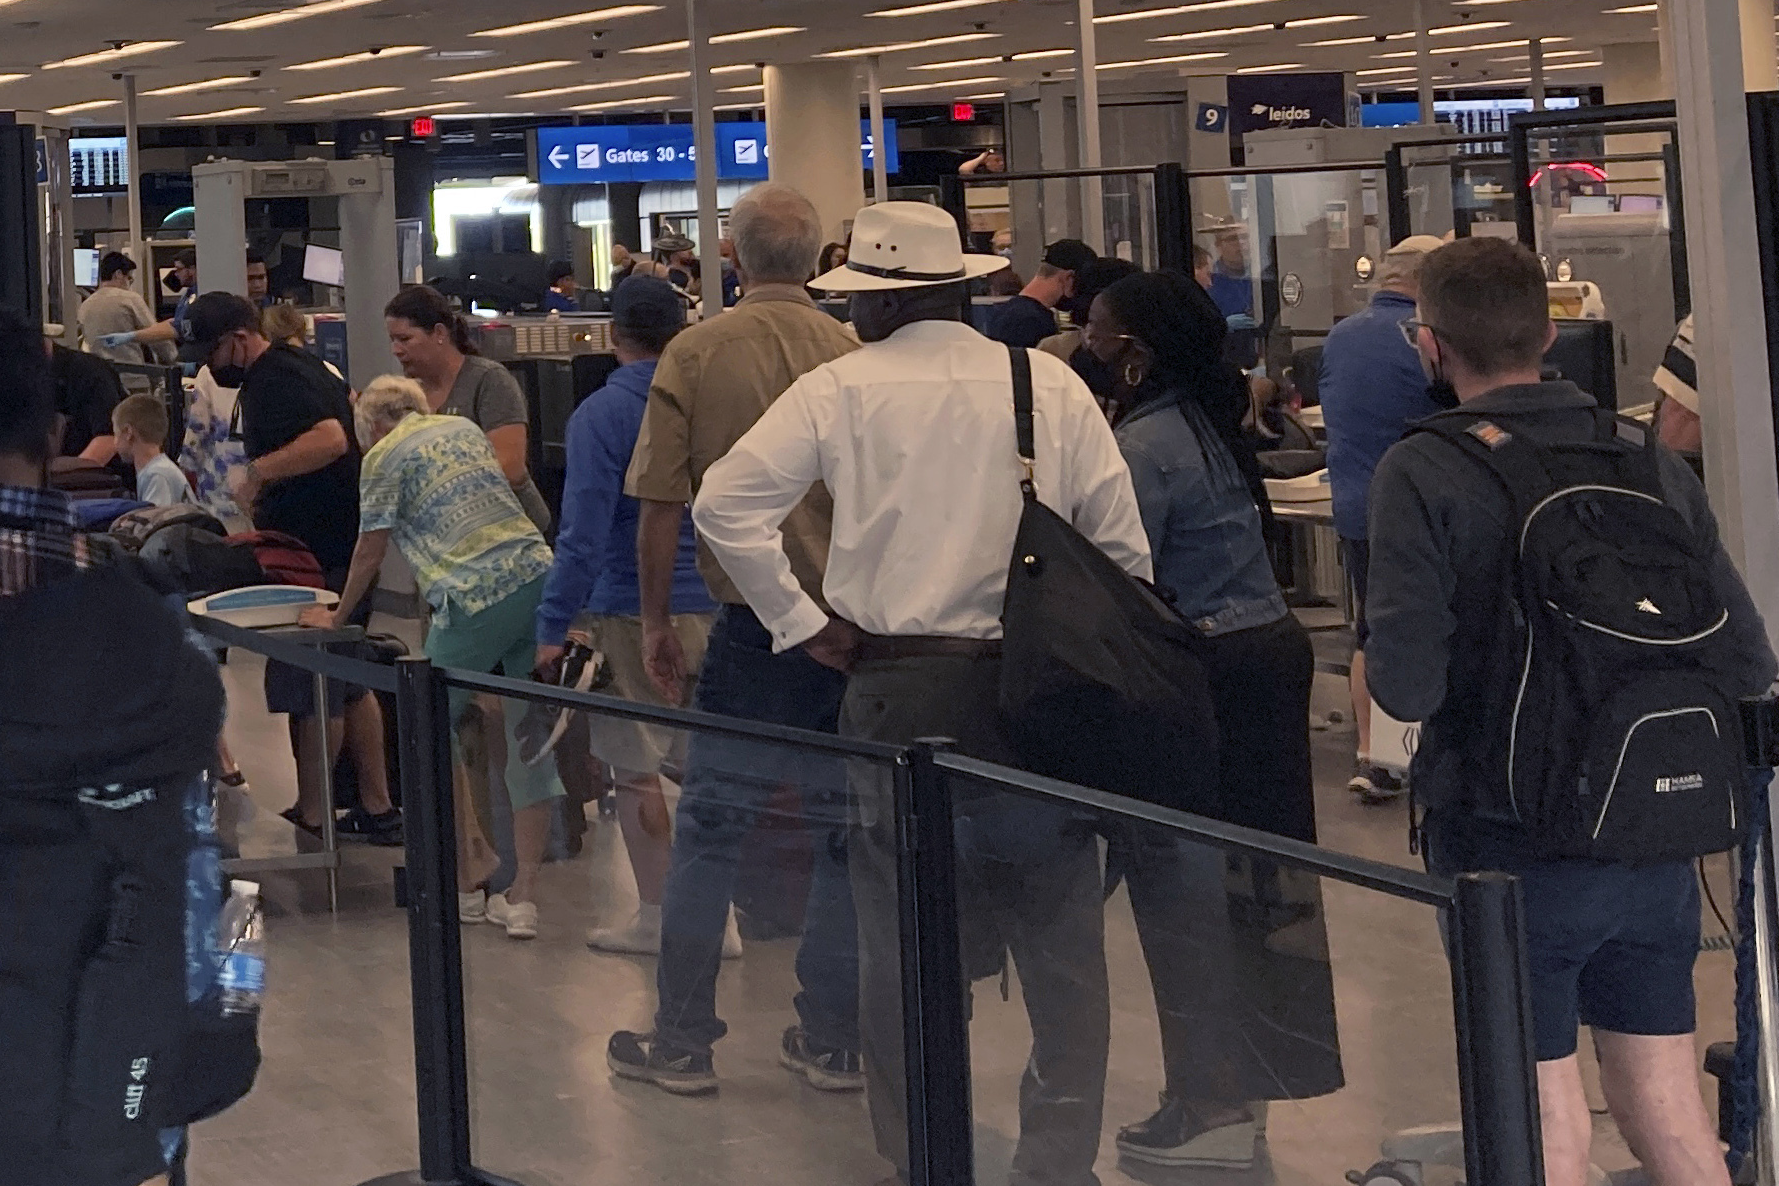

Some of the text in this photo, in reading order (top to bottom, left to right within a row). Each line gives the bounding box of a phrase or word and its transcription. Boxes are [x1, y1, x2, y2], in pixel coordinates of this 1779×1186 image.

[1205, 109, 1218, 126] 9
[1269, 106, 1311, 121] leidos
[606, 148, 649, 164] Gates
[656, 146, 675, 162] 30
